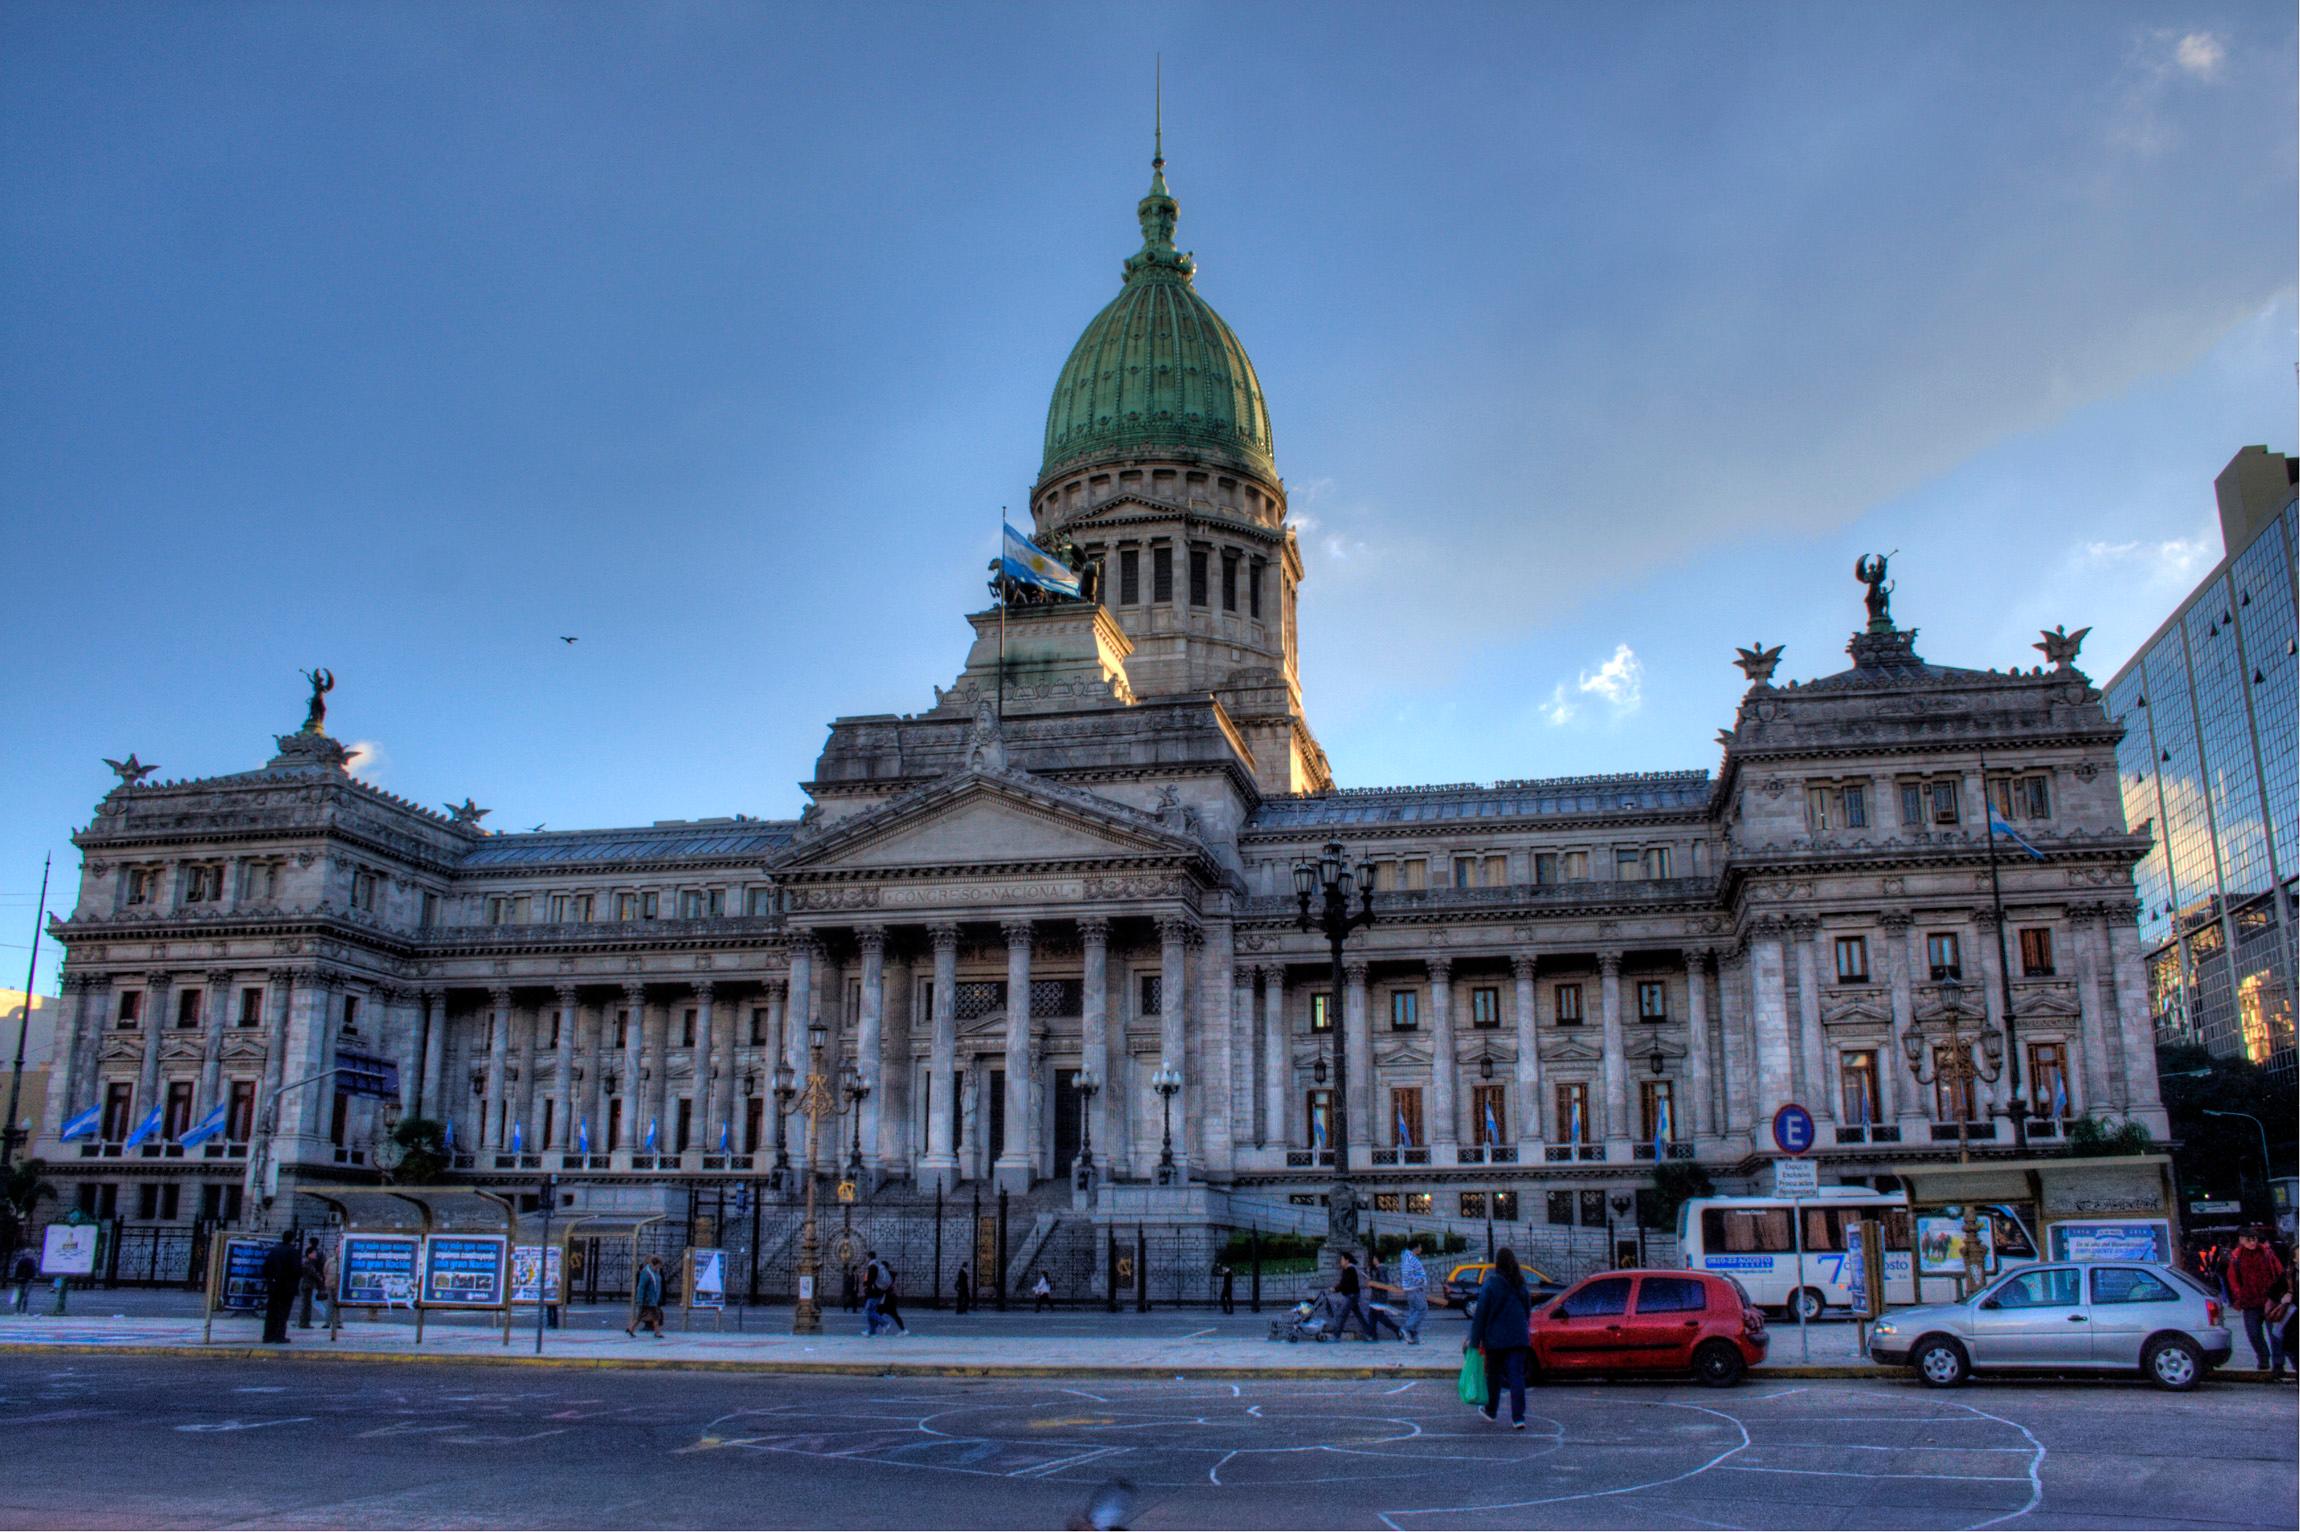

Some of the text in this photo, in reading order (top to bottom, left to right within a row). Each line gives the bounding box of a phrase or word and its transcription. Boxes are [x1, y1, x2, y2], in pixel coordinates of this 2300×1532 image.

[895, 883, 1070, 904] CONGRESO NACIONAL
[1786, 1115, 1804, 1146] E
[1818, 1254, 1846, 1284] 7
